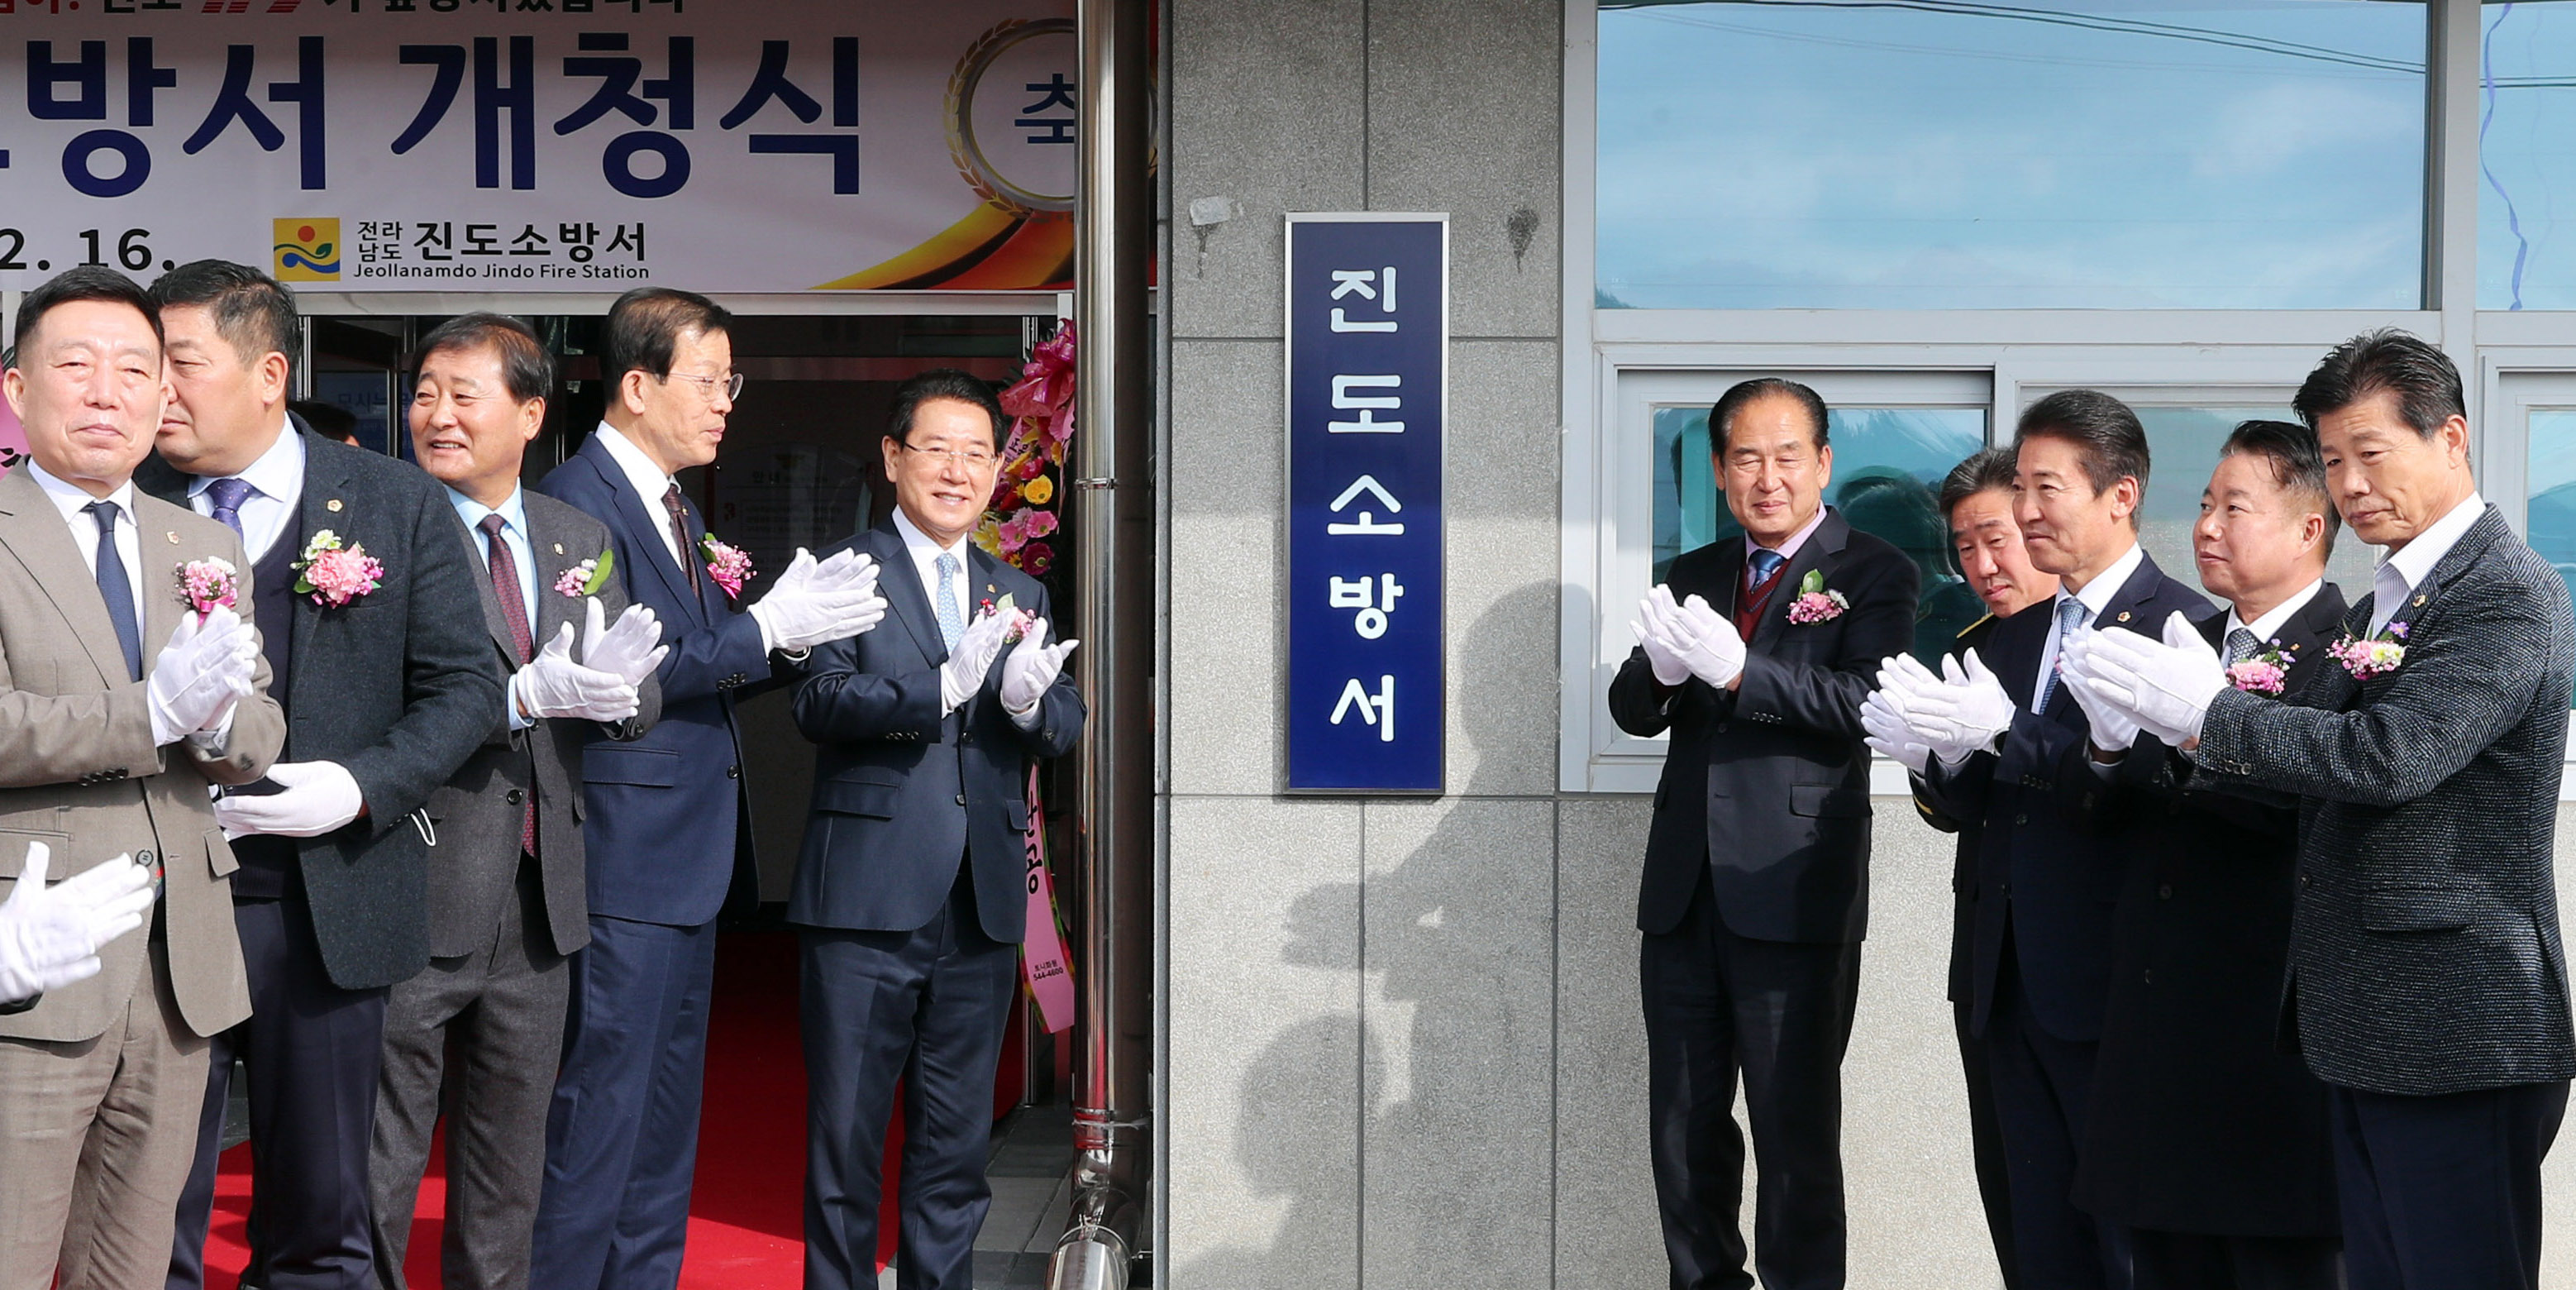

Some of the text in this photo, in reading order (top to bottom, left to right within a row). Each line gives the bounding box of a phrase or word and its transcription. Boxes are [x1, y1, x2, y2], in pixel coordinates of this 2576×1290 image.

[0, 32, 860, 198] 방서 개청식
[1014, 73, 1075, 145] 축
[0, 227, 175, 271] 2. 16.
[357, 221, 403, 241] 전라
[413, 221, 646, 263] 진도소방서
[353, 263, 650, 279] Jeollanamdo Jindo Fire Station
[357, 243, 403, 263] 남도
[1327, 265, 1406, 743] 진도소방서
